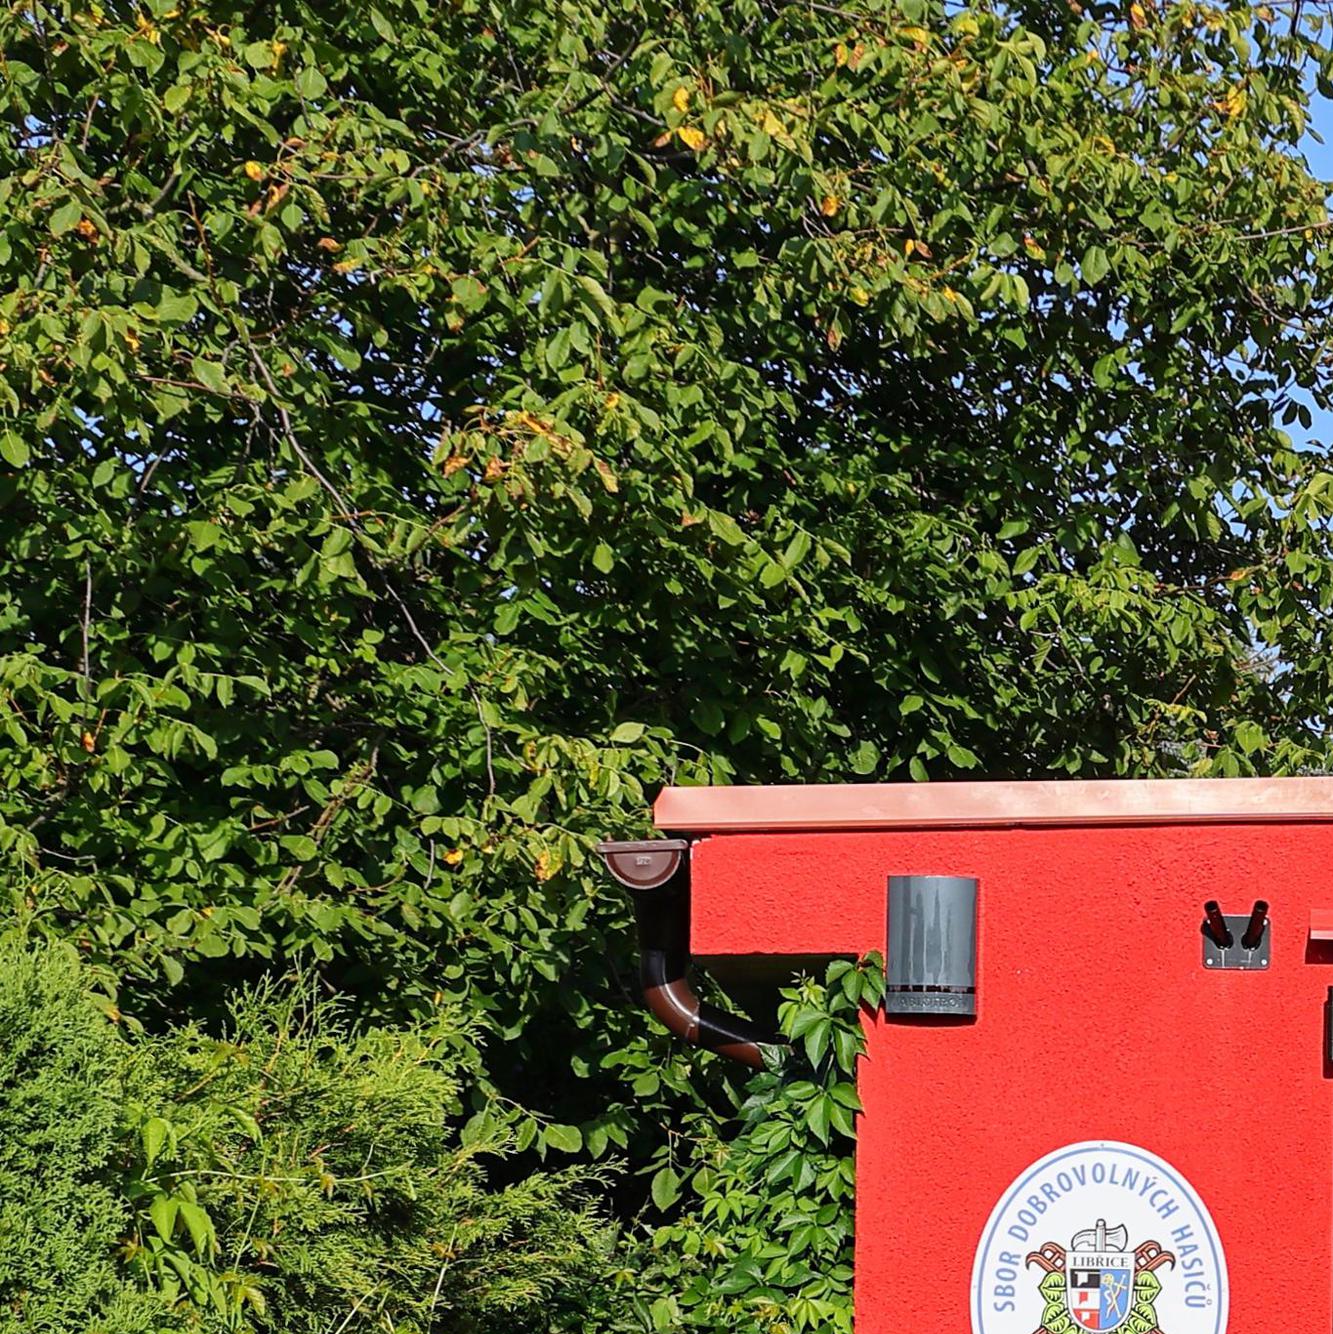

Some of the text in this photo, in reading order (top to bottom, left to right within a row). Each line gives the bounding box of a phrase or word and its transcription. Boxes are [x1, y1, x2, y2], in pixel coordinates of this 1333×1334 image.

[993, 1162, 1213, 1312] SBOR DOBROVOLNÝCH HASIČŮ
[1072, 1254, 1130, 1268] LIBŘICE
